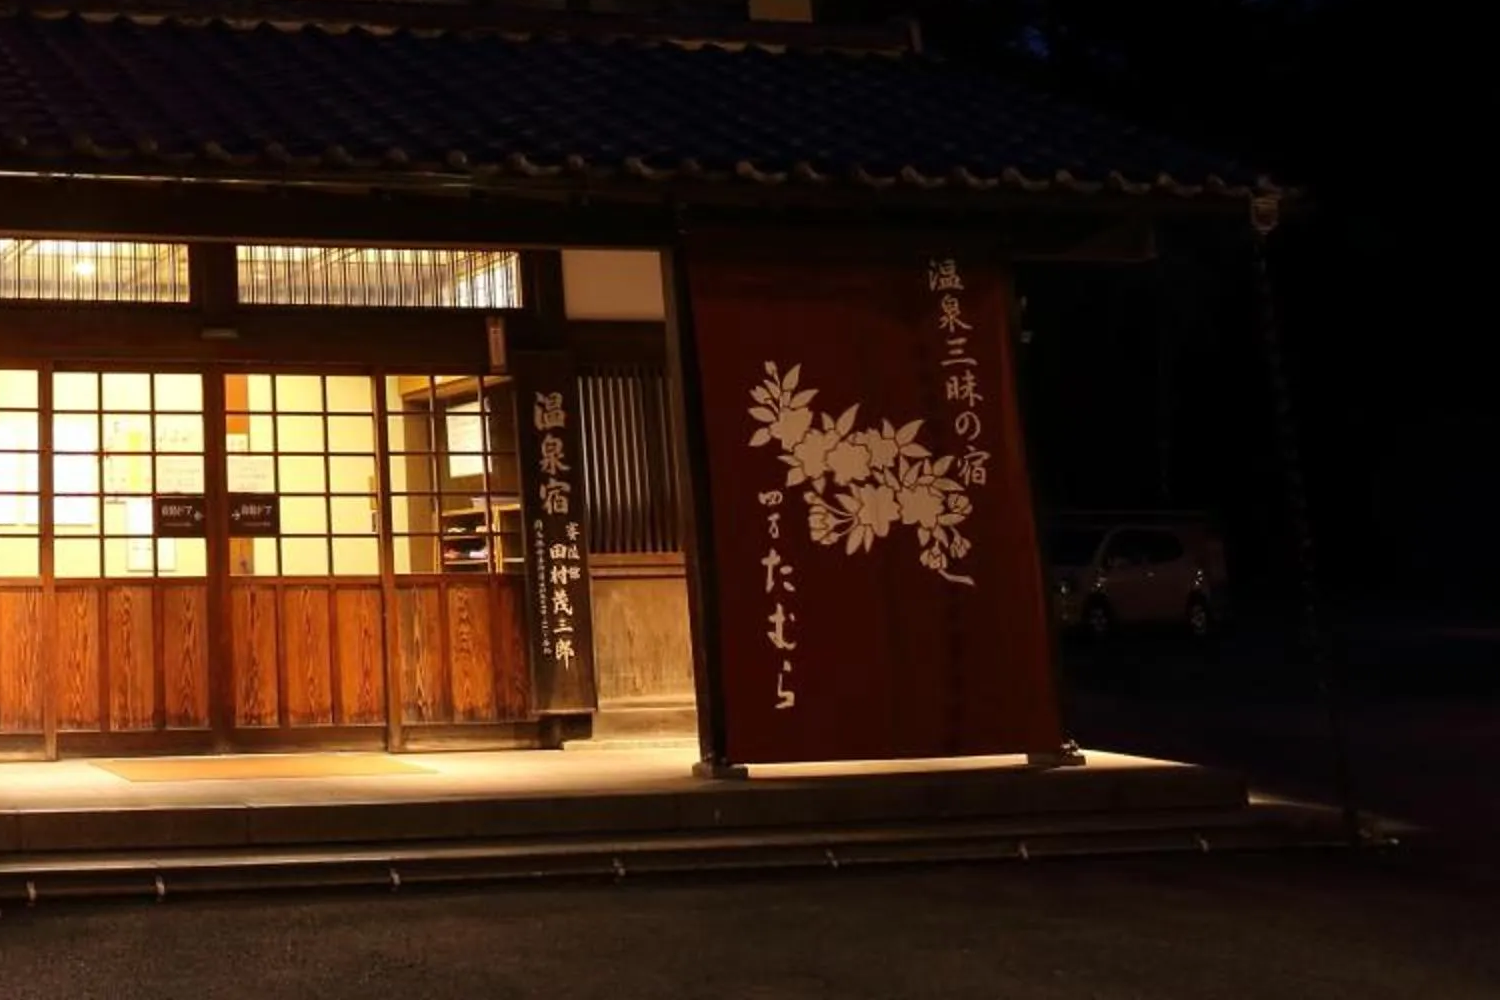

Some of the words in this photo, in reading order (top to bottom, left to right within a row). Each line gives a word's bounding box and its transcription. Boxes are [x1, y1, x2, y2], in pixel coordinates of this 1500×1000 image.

[928, 258, 992, 488] 温泉三昧の宿
[534, 391, 571, 515] 温泉宿
[549, 542, 576, 671] 田村茂三郎
